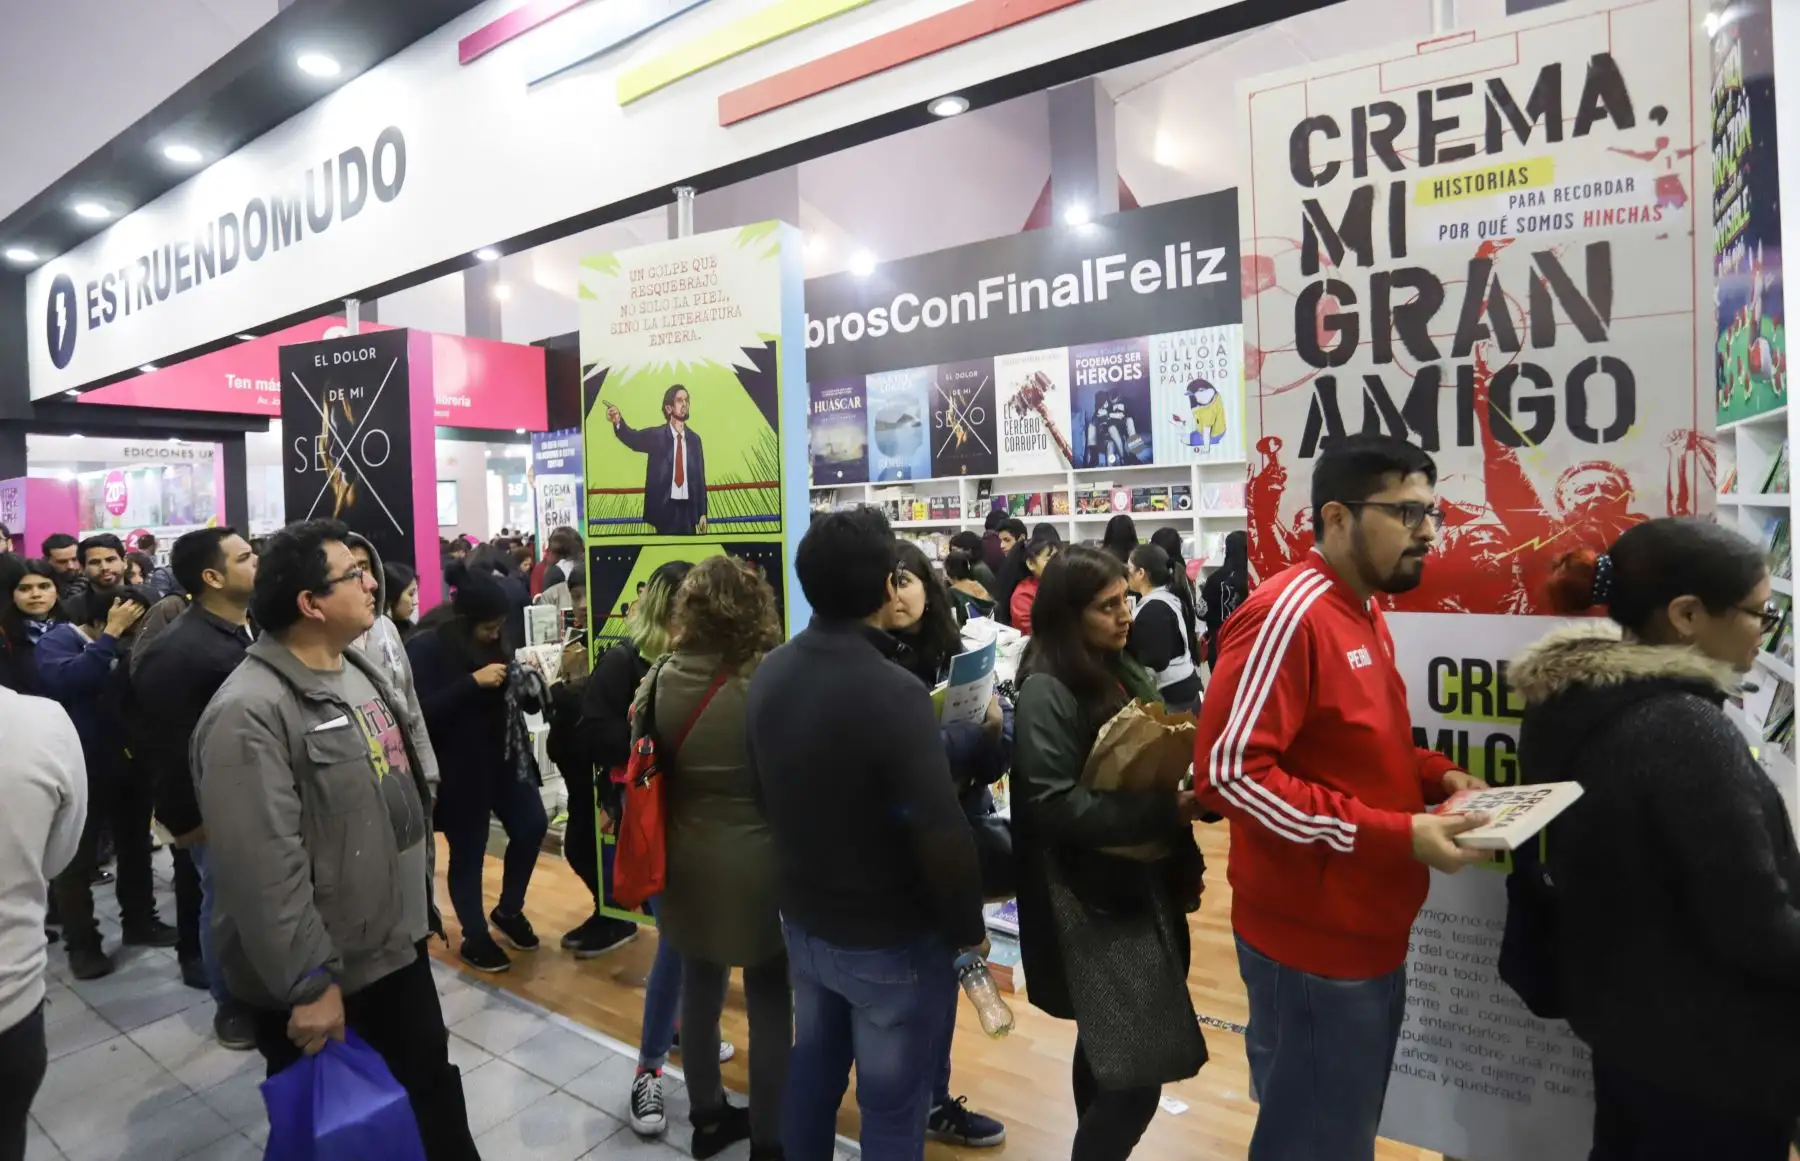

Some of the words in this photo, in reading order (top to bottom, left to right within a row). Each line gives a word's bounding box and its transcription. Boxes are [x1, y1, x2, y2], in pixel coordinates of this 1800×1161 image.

[1288, 51, 1669, 188] CREMA,
[1432, 167, 1530, 200] HISTORIAS
[1509, 187, 1546, 210] PARA
[1553, 177, 1636, 205] RECORDAR
[86, 125, 406, 330] ESTRUENDOMUDO
[1301, 180, 1407, 276] MI
[1439, 222, 1470, 241] POR
[1477, 214, 1509, 238] QUÉ
[1516, 212, 1574, 235] SOMOS
[1583, 204, 1663, 229] HINCHAS
[629, 268, 644, 283] UN
[648, 261, 688, 279] GOLPE
[693, 255, 718, 271] QUE
[631, 273, 718, 299] RESQUEBRAJÓ
[620, 304, 636, 318] NO
[639, 298, 670, 314] SOLO
[672, 295, 689, 310] LA
[1295, 240, 1613, 368] GRAN
[610, 320, 640, 335] SINO
[643, 316, 658, 330] LA
[663, 305, 742, 328] LITERATURA
[314, 354, 328, 367] EL
[333, 347, 376, 364] DOLOR
[1076, 354, 1123, 368] PODEMOS
[1125, 351, 1141, 363] SER
[1160, 344, 1226, 363] ULLOA
[946, 372, 954, 380] EL
[955, 371, 978, 379] DOLOR
[1160, 358, 1228, 374] DONOSO
[224, 373, 252, 389] Ten
[329, 388, 344, 402] DE
[350, 387, 364, 400] MI
[814, 396, 862, 413] HUASCAR
[1297, 355, 1637, 459] AMIGO
[1004, 417, 1040, 435] CEREBRO
[124, 446, 195, 459] EDICIONES
[1005, 434, 1047, 452] CORRUPTO
[543, 484, 570, 497] CREMA
[545, 510, 571, 526] GRAN
[1461, 914, 1481, 928] no
[1419, 942, 1442, 957] del
[1413, 959, 1448, 977] para
[1453, 966, 1489, 985] todo
[1450, 985, 1480, 1001] que
[1449, 1001, 1469, 1016] de
[1478, 1010, 1546, 1034] consulta
[1525, 1036, 1562, 1054] Este
[1460, 1041, 1505, 1061] sobre
[1511, 1053, 1542, 1069] una
[1401, 1046, 1438, 1064] años
[1445, 1057, 1474, 1073] nos
[1481, 1064, 1536, 1087] dijeron
[1544, 1080, 1576, 1097] que
[1441, 1073, 1450, 1087] y
